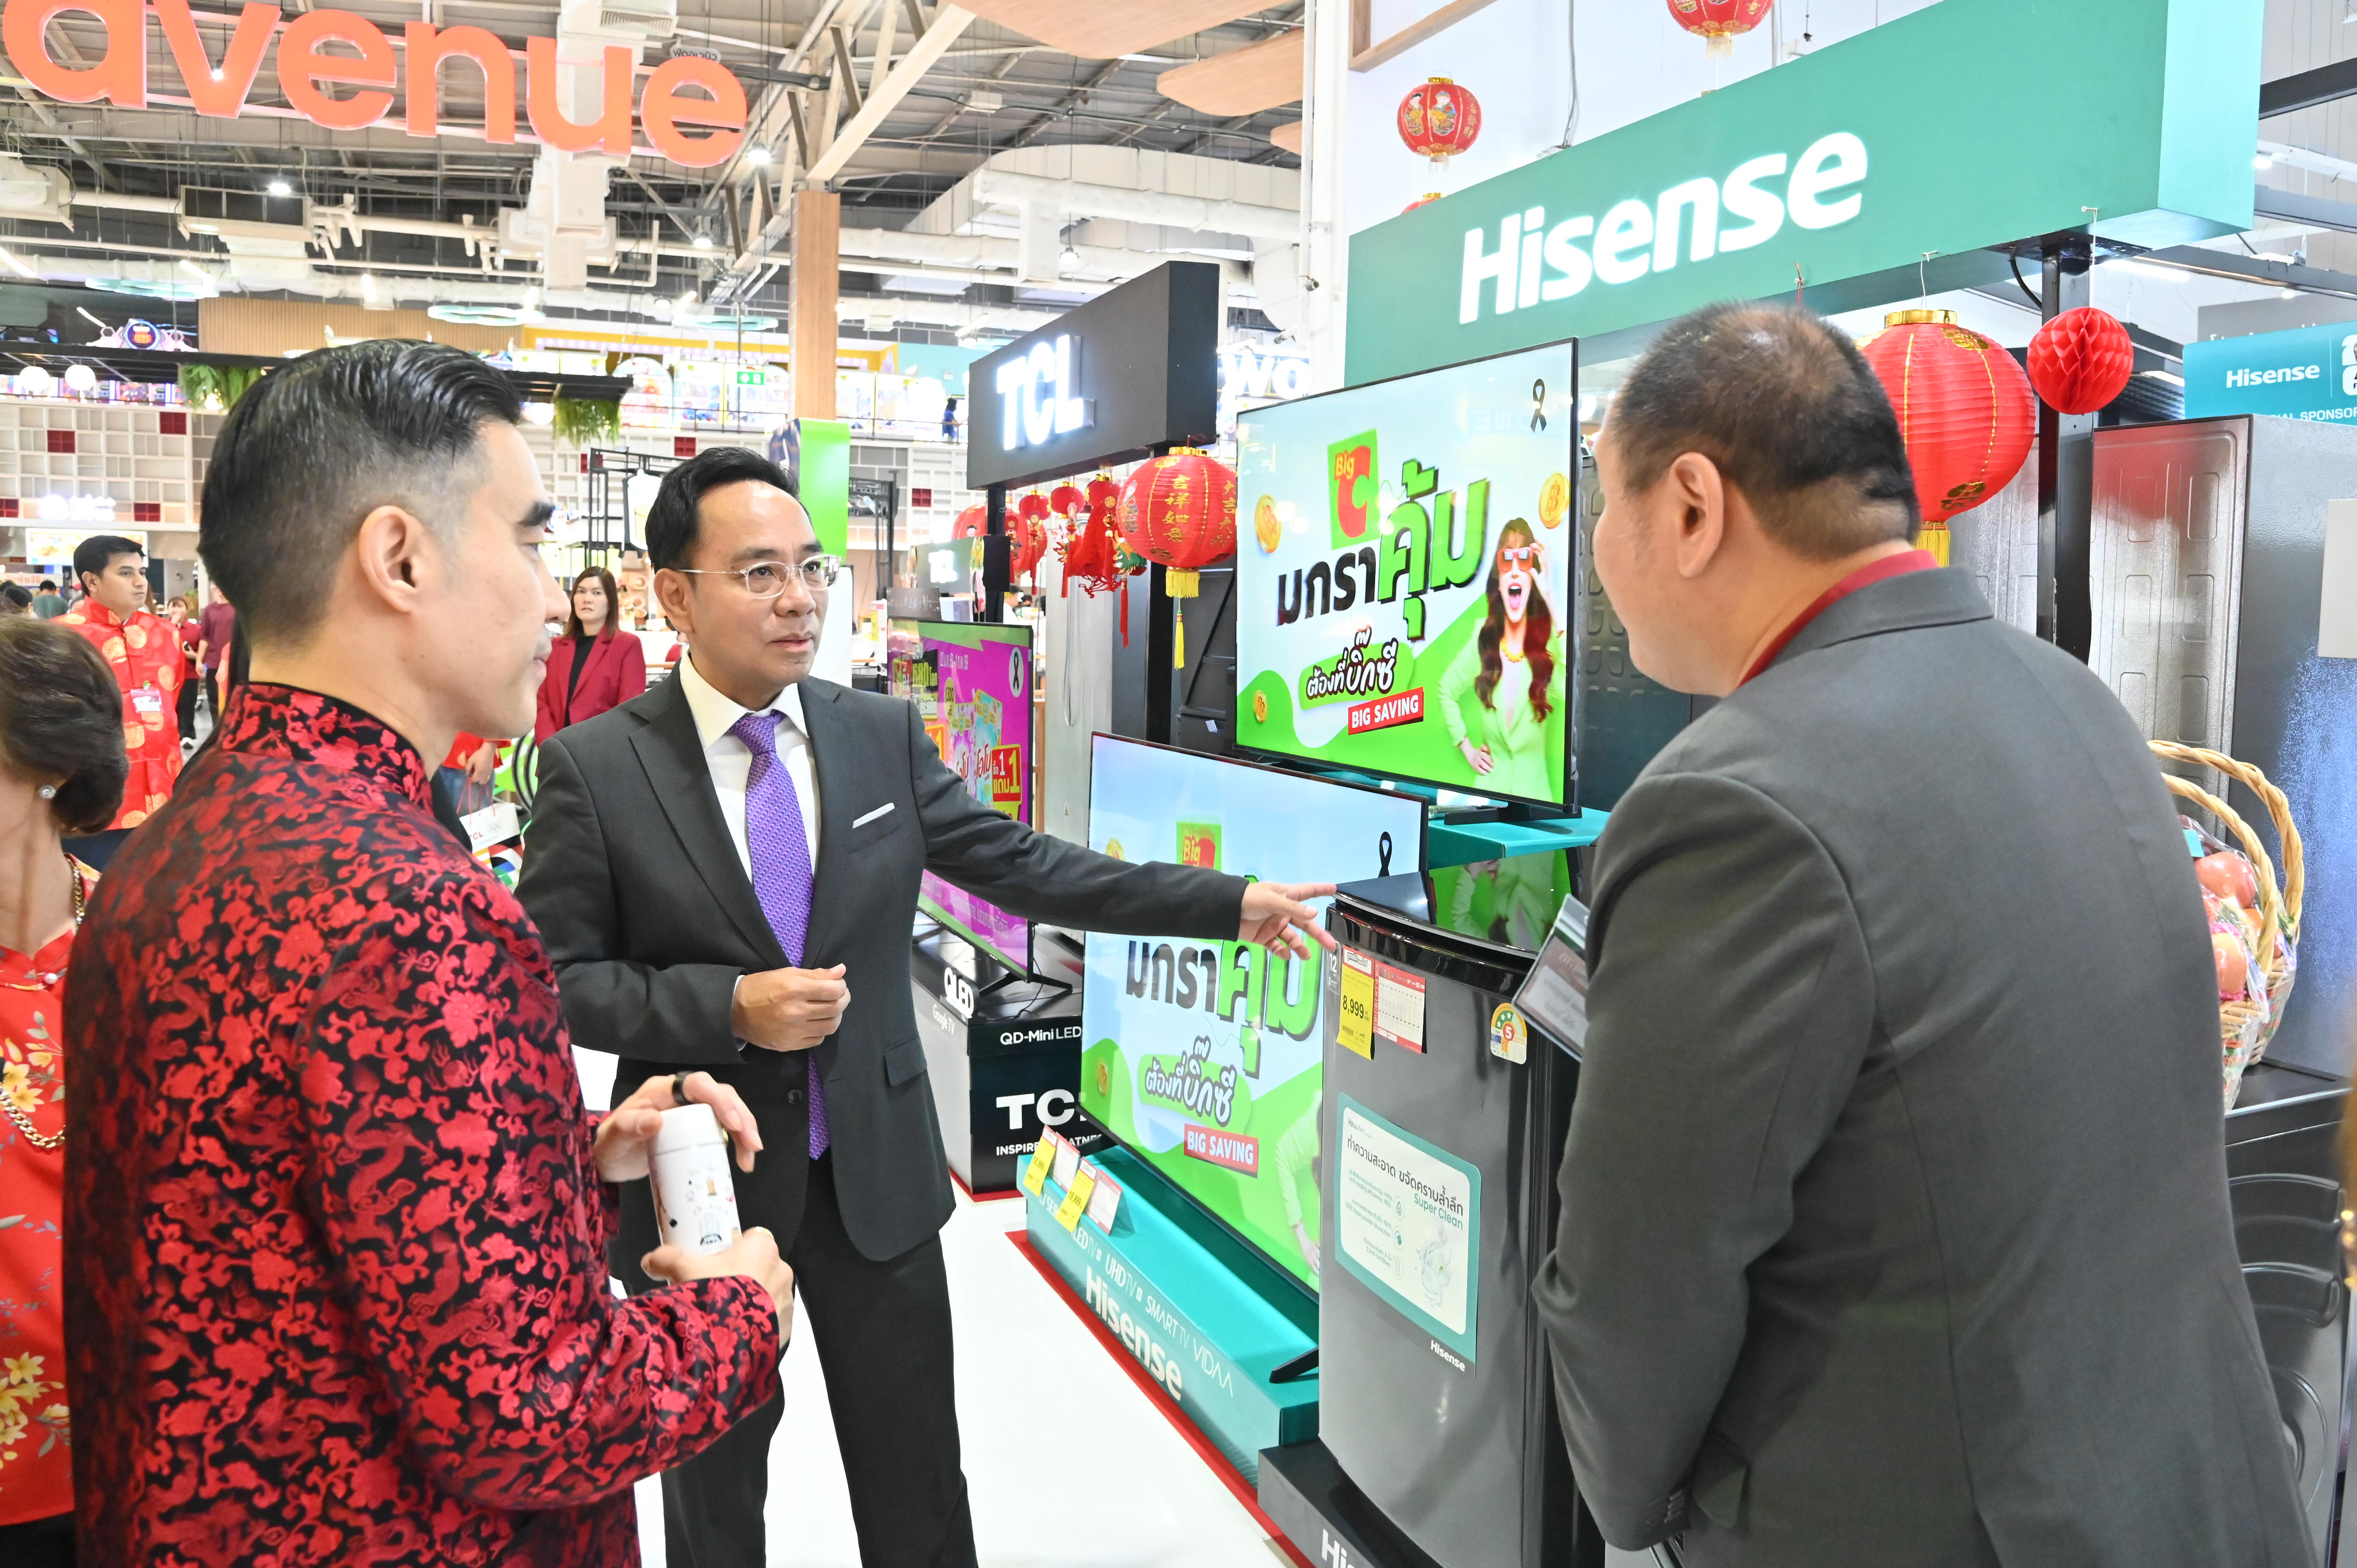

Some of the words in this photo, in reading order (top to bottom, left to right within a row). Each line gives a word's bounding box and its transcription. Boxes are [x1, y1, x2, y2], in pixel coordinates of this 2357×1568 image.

[4, 0, 748, 168] avenue
[1459, 132, 1868, 325] Hisense
[996, 334, 1085, 451] TCL
[2226, 365, 2320, 388] Hisense
[1334, 449, 1355, 480] Big
[1351, 706, 1372, 729] BIG
[1374, 695, 1419, 724] SAVING
[993, 778, 1010, 794] แถม
[1009, 750, 1021, 793] 1
[1000, 751, 1005, 776] 1
[1330, 953, 1337, 973] 12
[944, 967, 974, 1016] QLED
[1343, 995, 1364, 1019] 8,999
[948, 1017, 955, 1035] TV
[1000, 1028, 1054, 1045] QD-Mini
[1056, 1026, 1082, 1040] LED
[1505, 1025, 1512, 1039] 5
[996, 1088, 1087, 1130] TC
[1187, 1133, 1207, 1155] BIG
[1209, 1137, 1254, 1166] SAVING
[1347, 1134, 1396, 1178] ทำความสะอาด
[1068, 1190, 1082, 1206] 19,999
[1414, 1193, 1437, 1215] Super
[1438, 1210, 1463, 1231] Clean
[1071, 1227, 1089, 1249] LED
[1105, 1254, 1126, 1287] UHD
[1125, 1271, 1138, 1298] TV
[1145, 1295, 1179, 1337] SMART
[1179, 1325, 1190, 1348] TV
[1085, 1265, 1182, 1401] Hisense
[1430, 1339, 1465, 1372] Hisense
